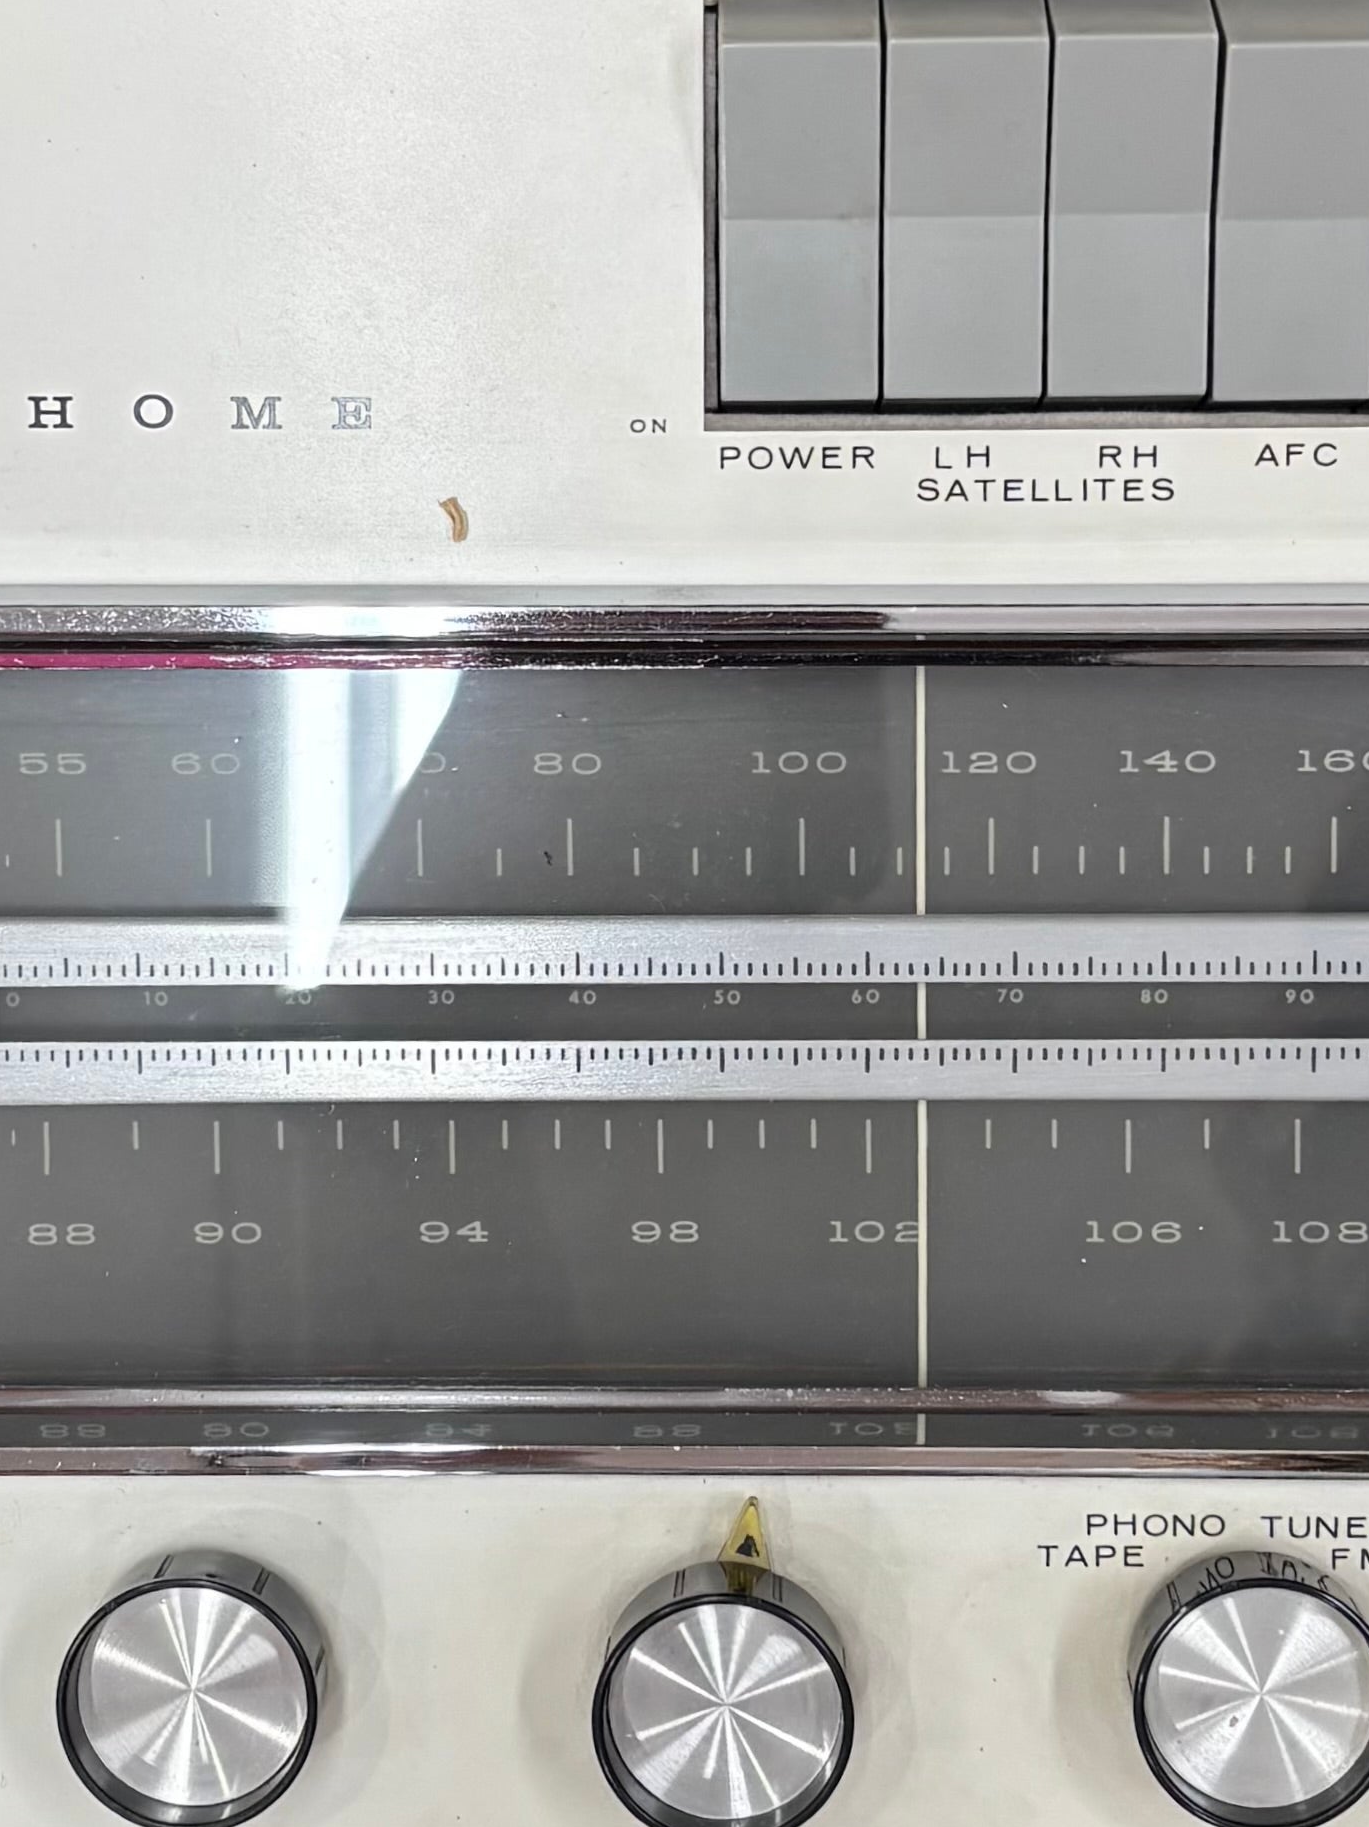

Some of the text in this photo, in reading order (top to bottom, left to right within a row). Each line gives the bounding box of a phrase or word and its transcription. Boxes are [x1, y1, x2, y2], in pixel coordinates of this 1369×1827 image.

[629, 418, 667, 434] ON
[720, 445, 875, 470] POWER
[935, 445, 990, 470] LH
[1098, 445, 1158, 469] RH
[1254, 442, 1338, 467] AFC
[917, 477, 1175, 503] SATELLITES
[19, 752, 87, 775] 55
[171, 752, 241, 775] 60
[533, 752, 602, 775] 80
[751, 751, 847, 774] 100
[941, 750, 1037, 774] 120
[1119, 749, 1216, 773] 140
[5, 992, 21, 1008] 0
[144, 990, 169, 1007] 10
[428, 989, 455, 1005] 30
[568, 989, 597, 1005] 40
[713, 989, 741, 1005] 50
[851, 988, 880, 1005] 60
[997, 988, 1024, 1004] 70
[1140, 988, 1169, 1004] 80
[1285, 988, 1315, 1005] 90
[27, 1220, 1369, 1246] 88 90 94 98 102 106 108
[1086, 1513, 1226, 1537] PHONO
[1037, 1544, 1145, 1568] TAPE
